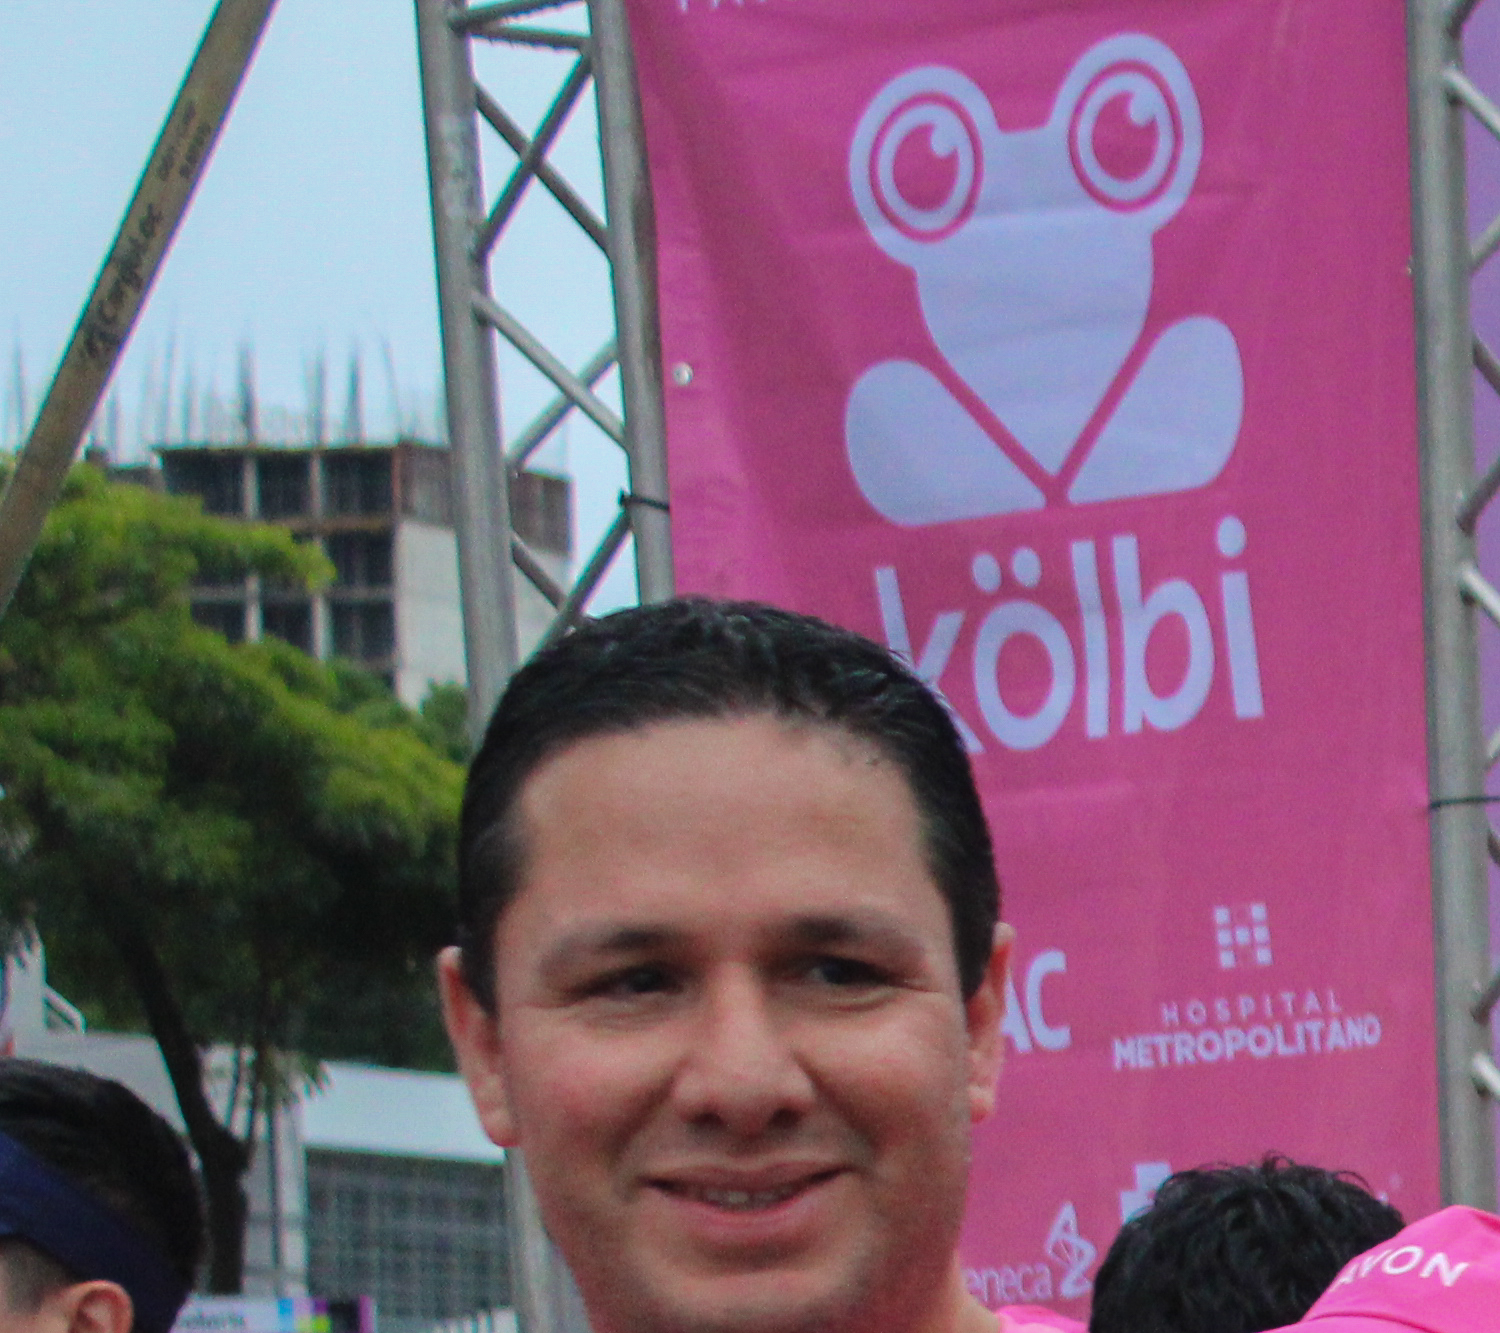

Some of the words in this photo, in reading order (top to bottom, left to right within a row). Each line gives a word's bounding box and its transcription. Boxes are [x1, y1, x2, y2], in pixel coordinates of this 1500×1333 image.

[875, 515, 1265, 755] kölbi
[1000, 948, 1071, 1053] AC
[1162, 989, 1342, 1027] HOSPITAL
[1113, 1013, 1382, 1070] METROPOLITANO
